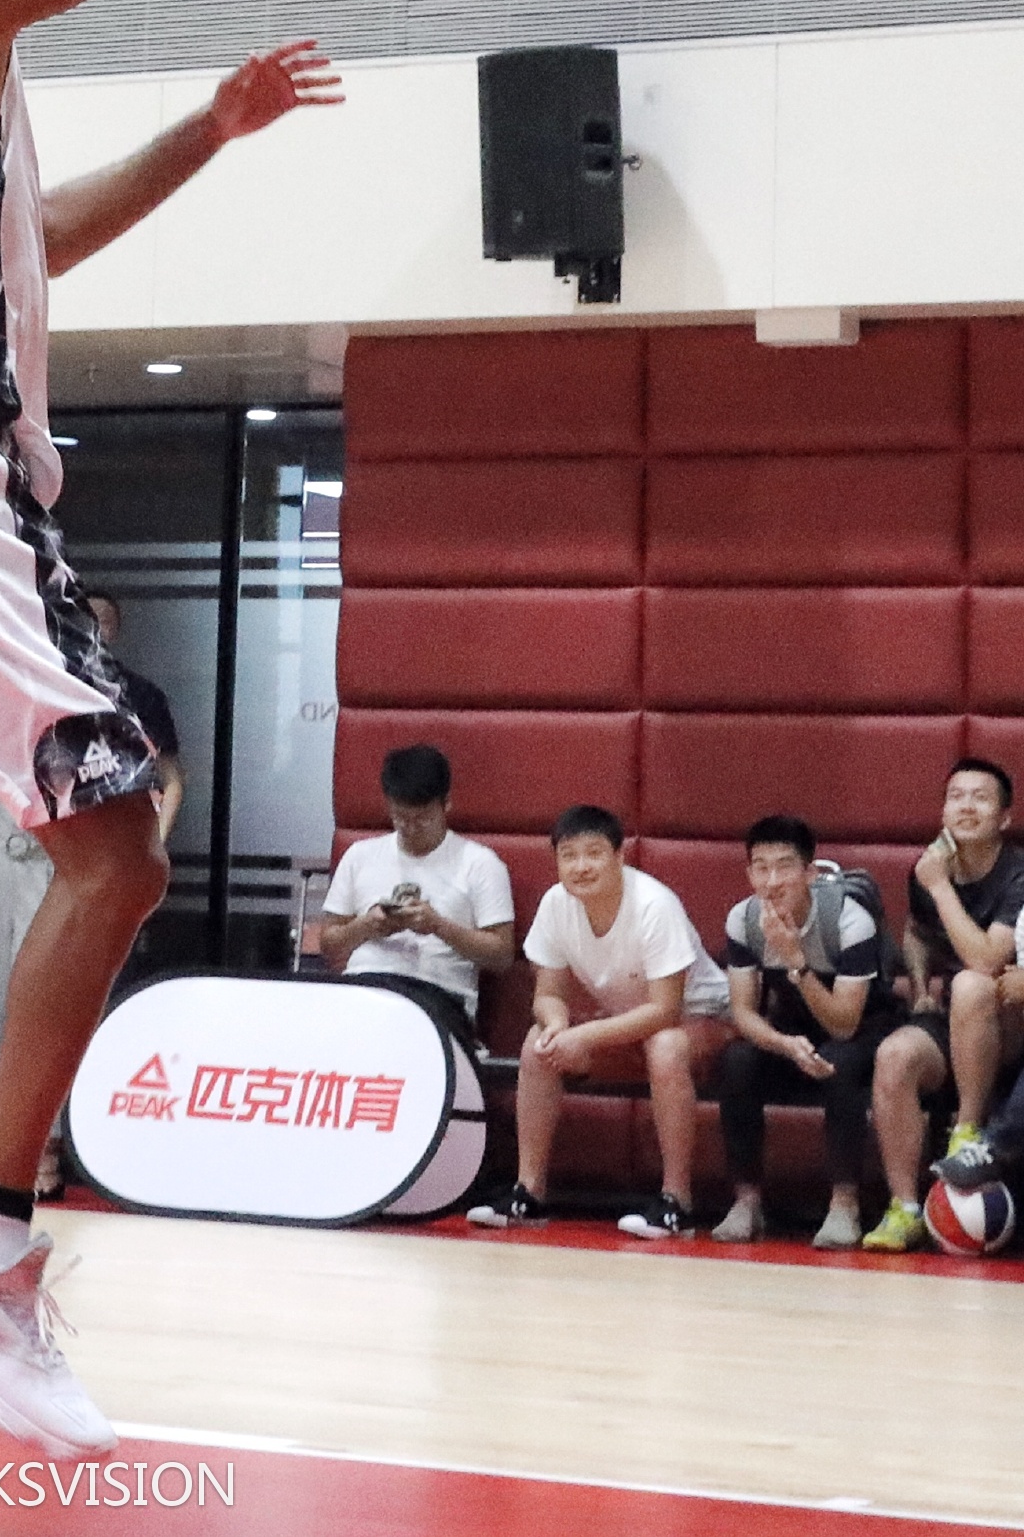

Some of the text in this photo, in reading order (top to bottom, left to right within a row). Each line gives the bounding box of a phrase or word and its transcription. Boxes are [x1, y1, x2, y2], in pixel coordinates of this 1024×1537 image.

[108, 1091, 182, 1121] PEAK
[186, 1064, 405, 1132] 匹克体育
